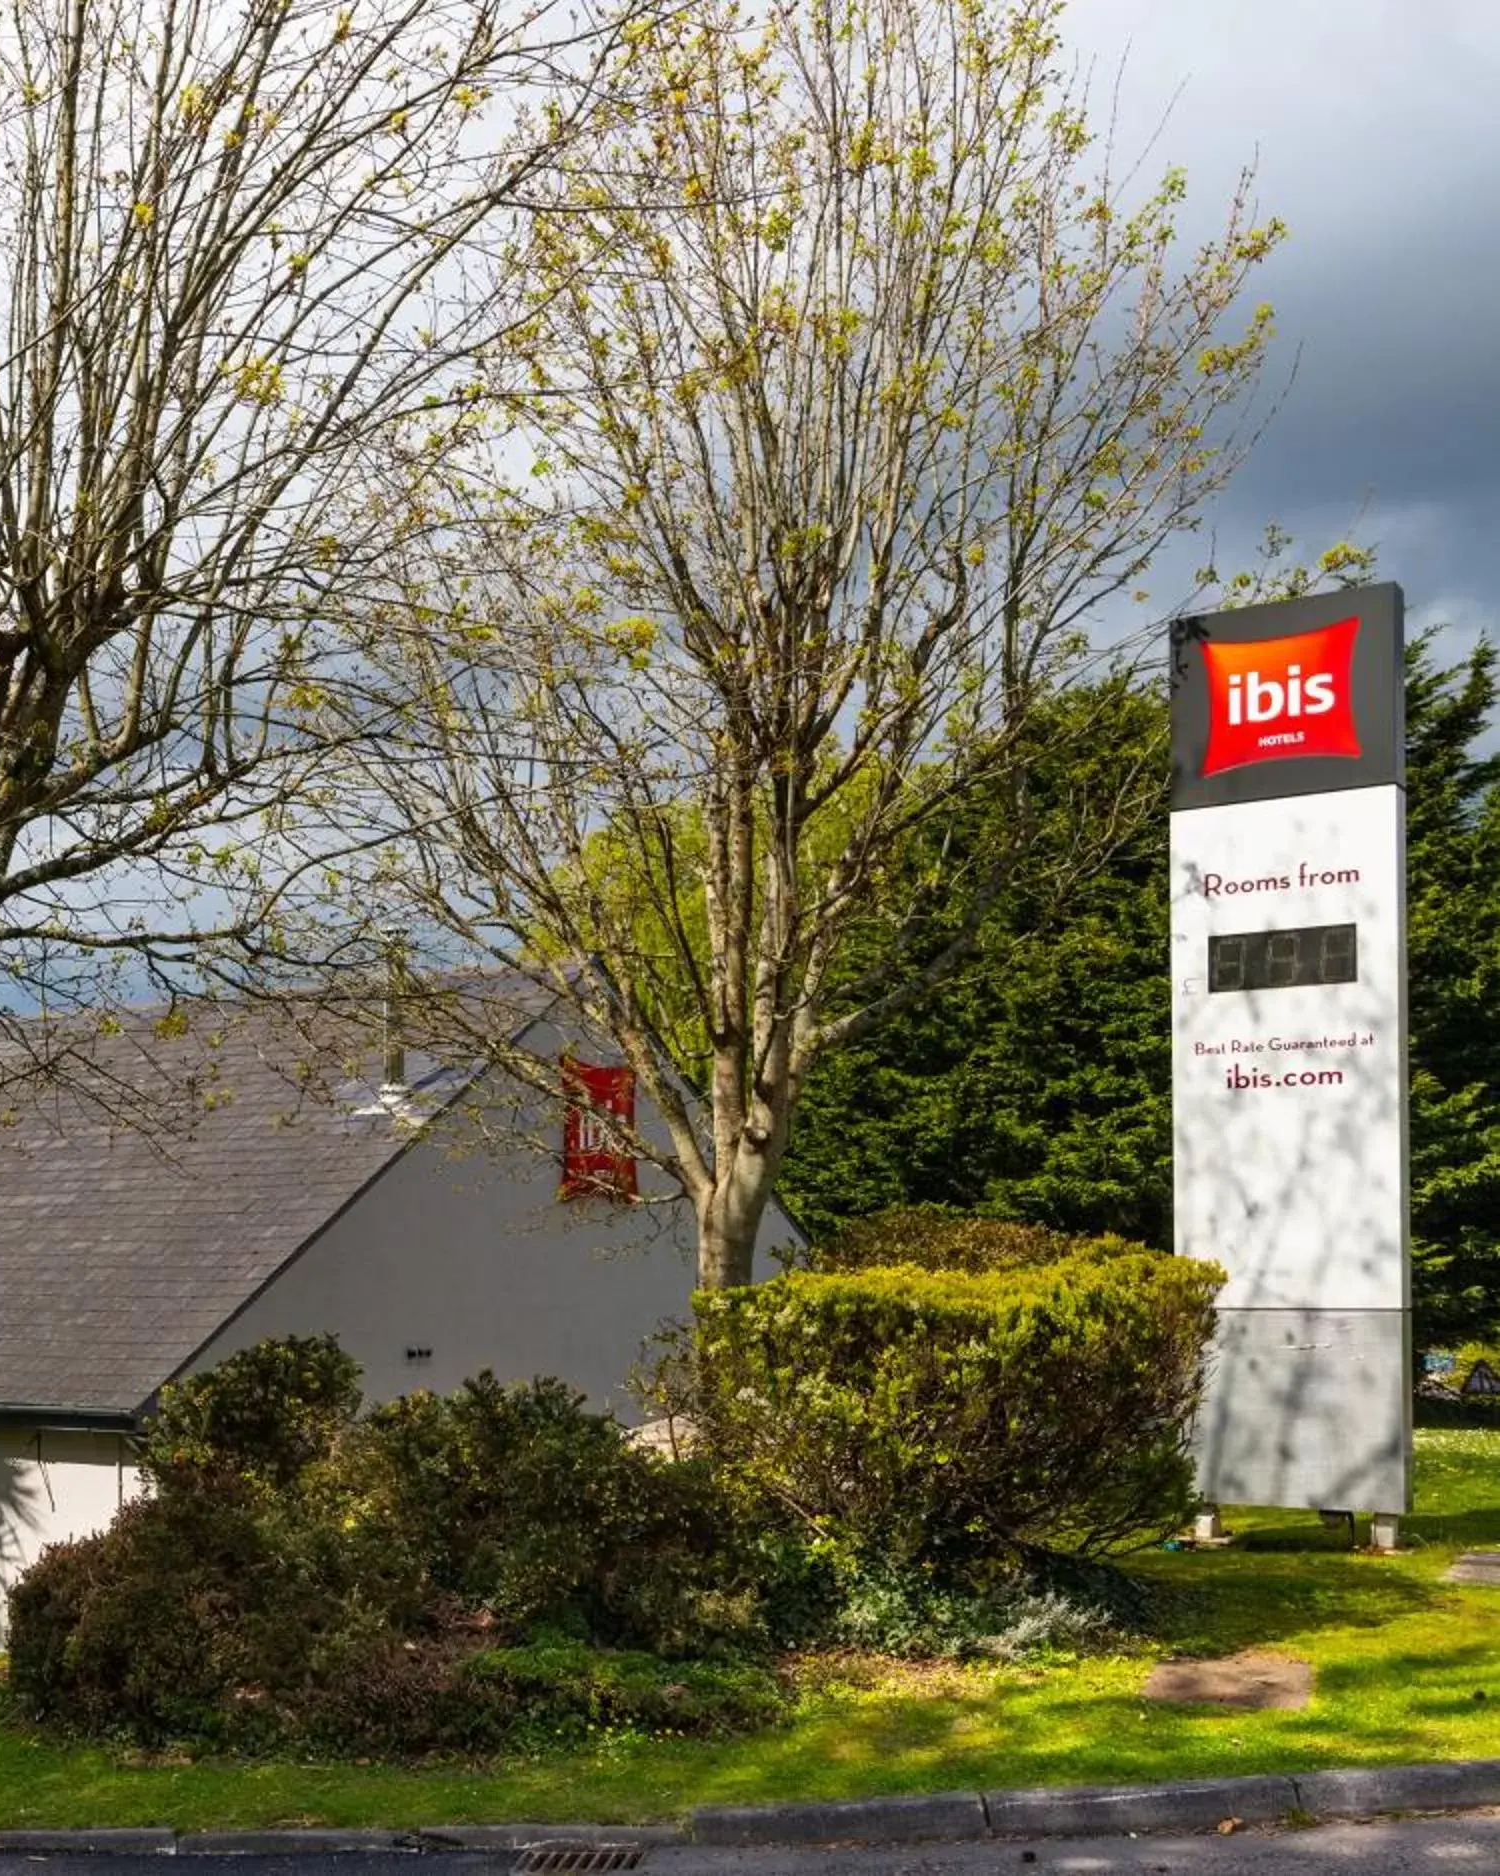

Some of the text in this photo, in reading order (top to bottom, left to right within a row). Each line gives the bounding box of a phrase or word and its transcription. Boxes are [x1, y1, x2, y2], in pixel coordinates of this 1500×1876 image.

[1228, 665, 1335, 725] ibis
[1258, 731, 1305, 747] HOTELS
[1204, 862, 1360, 897] Rooms from
[1194, 1033, 1374, 1056] Best Rate Guaranteed at
[1226, 1064, 1343, 1089] ibis.com
